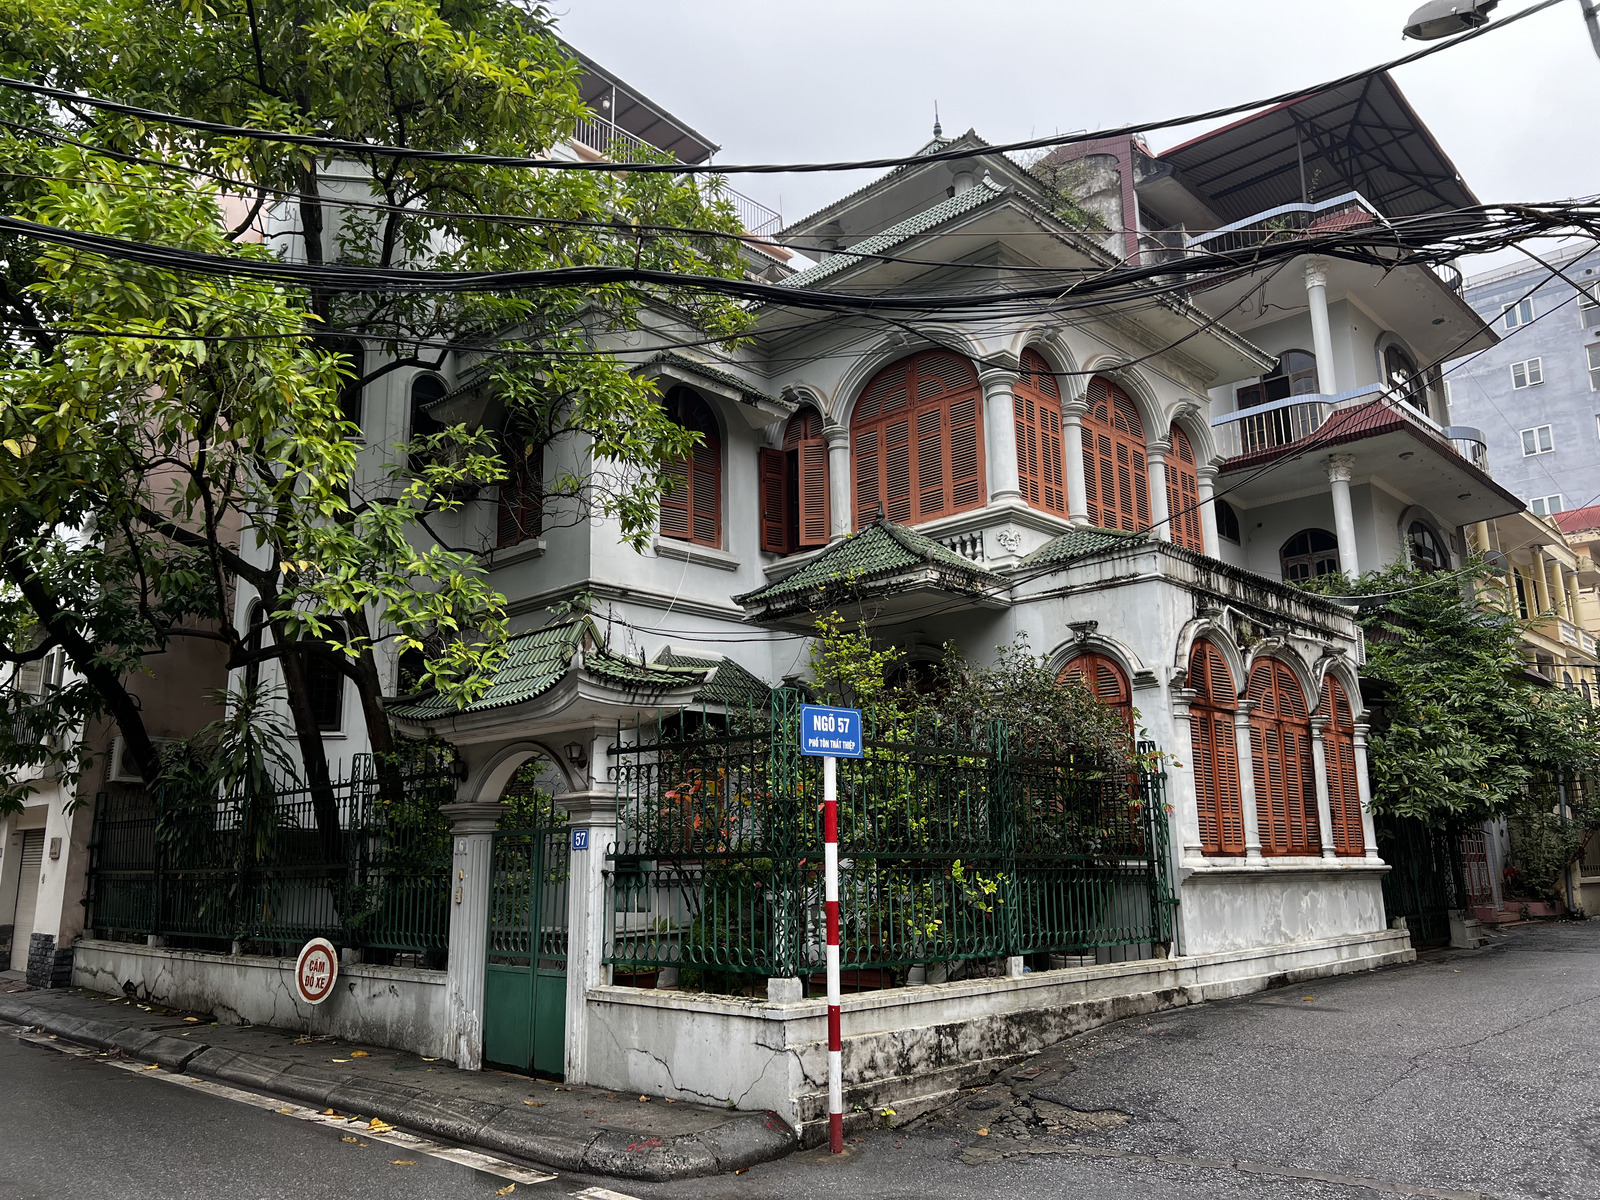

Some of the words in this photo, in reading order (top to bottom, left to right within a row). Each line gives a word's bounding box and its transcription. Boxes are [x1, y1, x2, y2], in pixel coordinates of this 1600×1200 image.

[813, 713, 836, 732] NGÕ
[837, 717, 850, 733] 57
[808, 736, 819, 748] PHỐ
[819, 737, 830, 748] TÔN
[830, 738, 842, 749] THẤT
[842, 740, 856, 752] THIỆP
[575, 832, 586, 846] 57
[309, 957, 325, 973] CẤM
[305, 973, 315, 988] ĐỖ
[315, 977, 325, 989] XE
